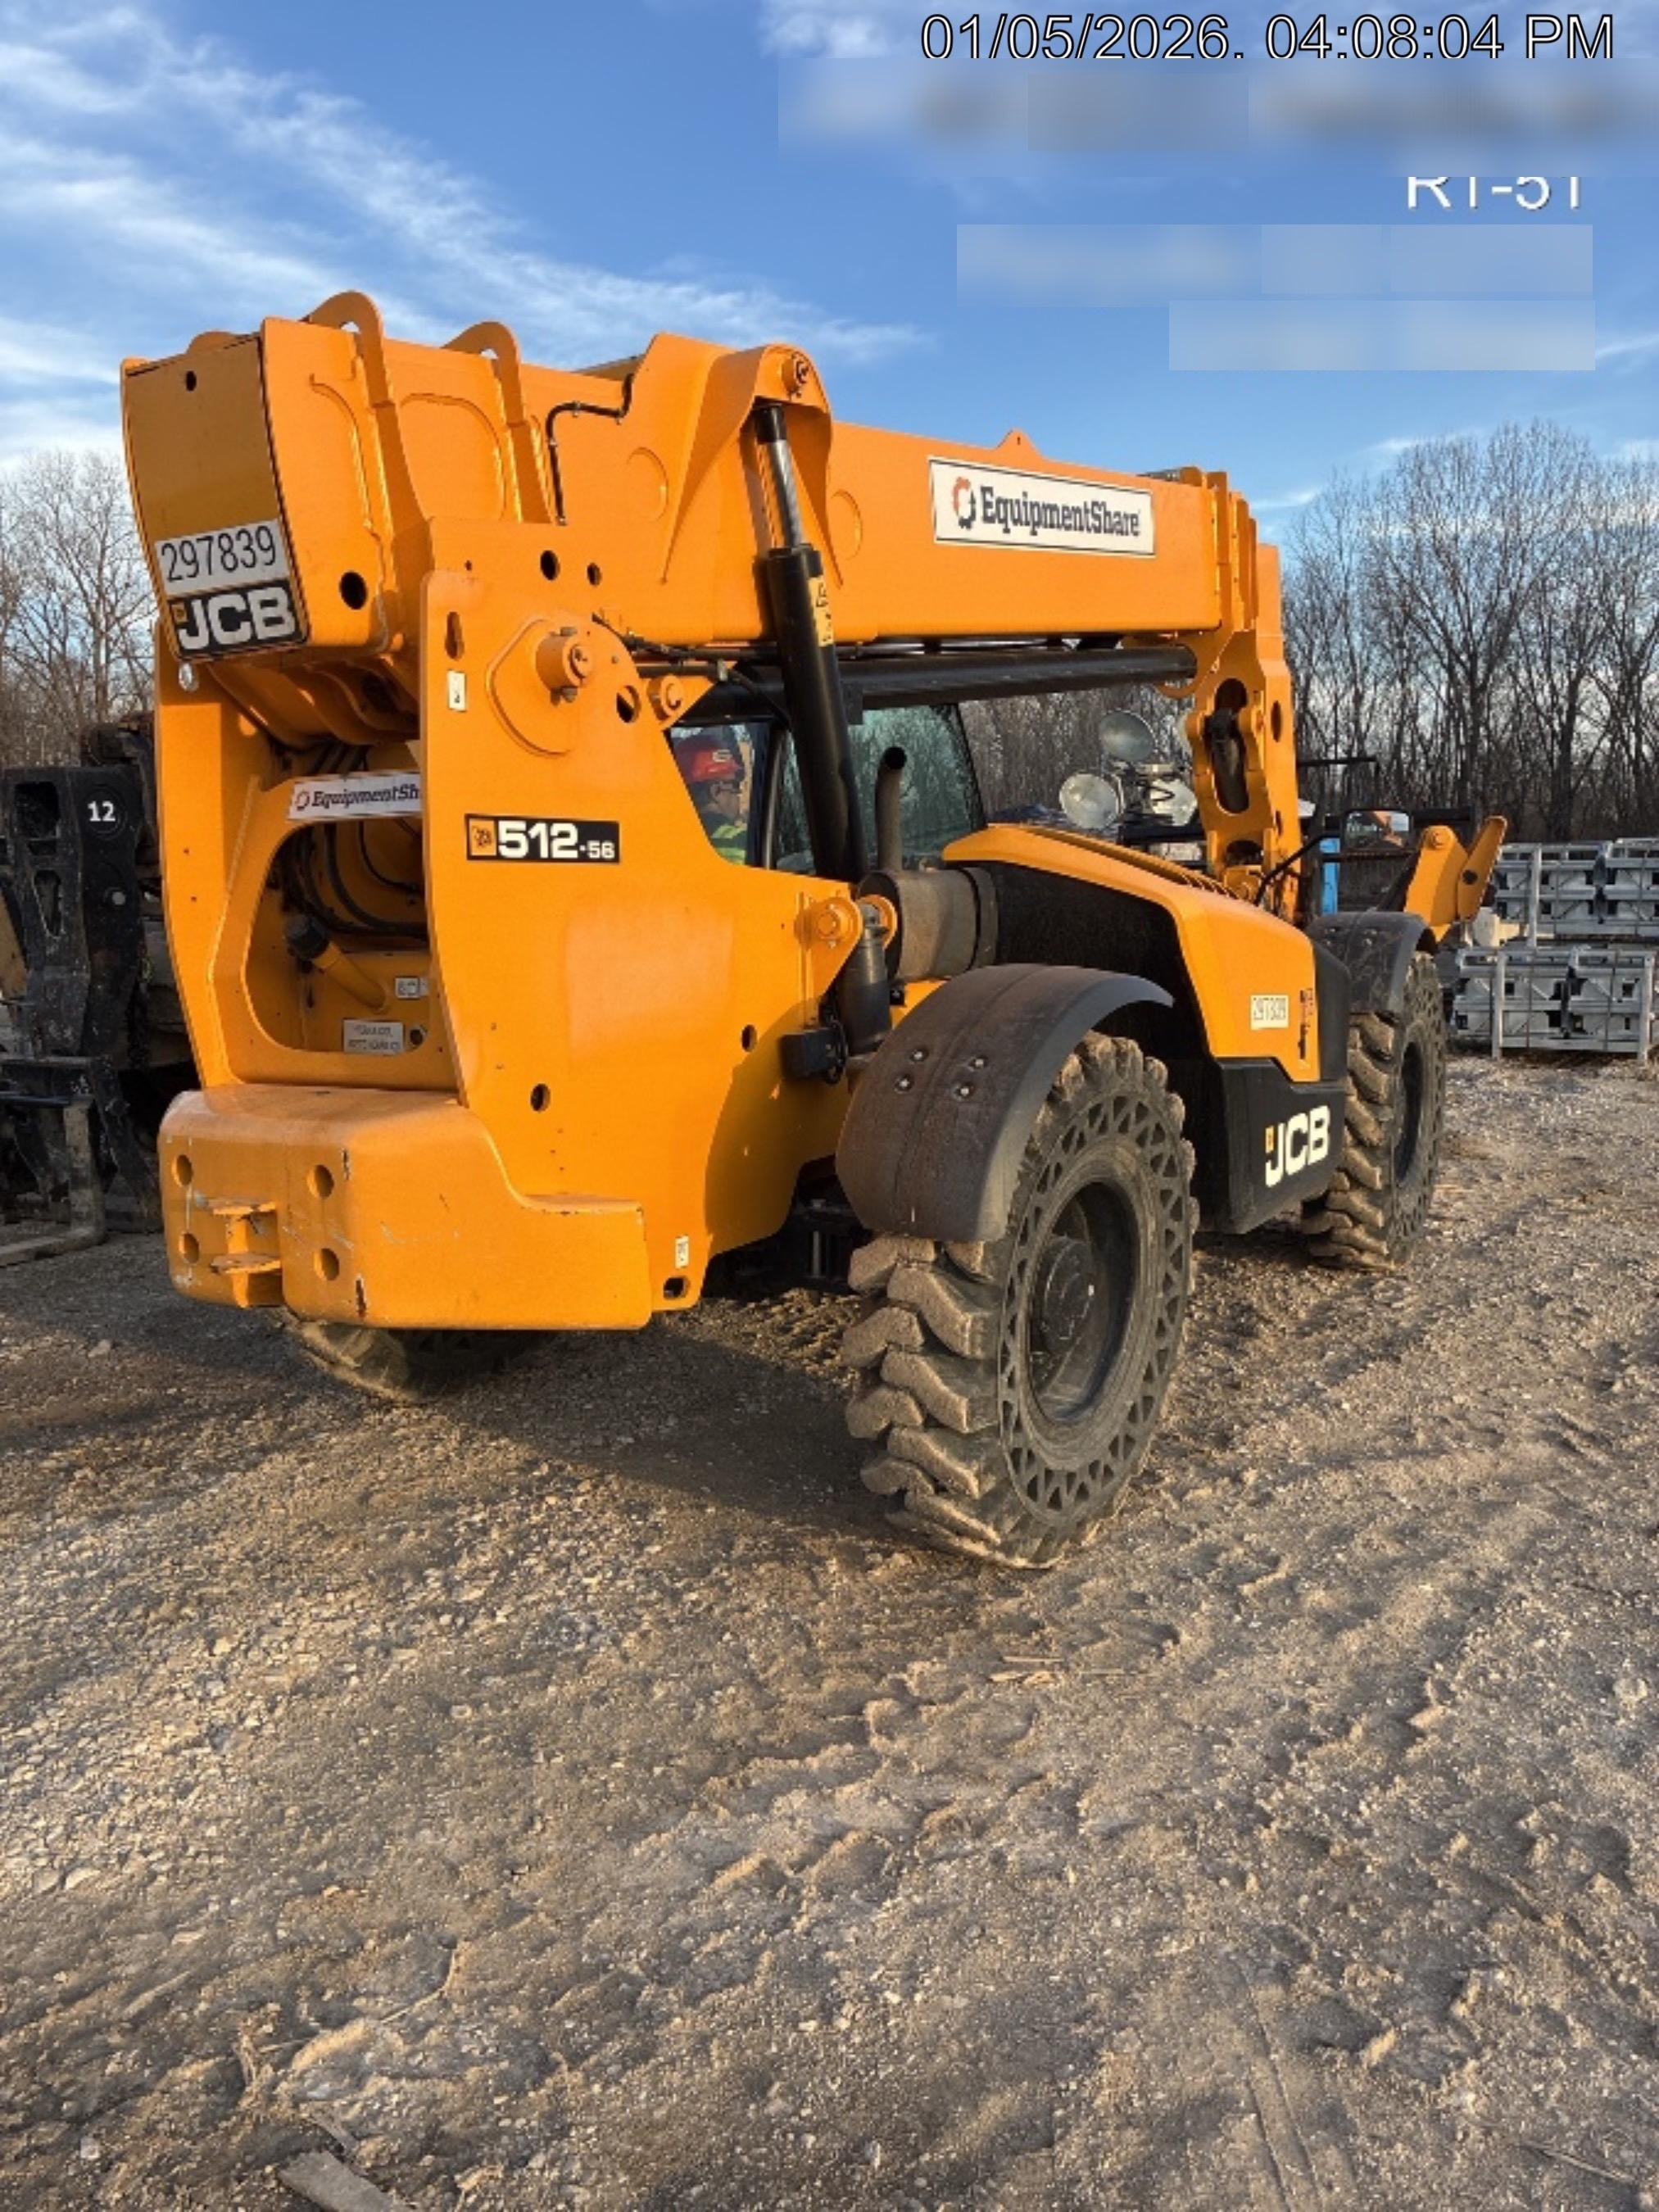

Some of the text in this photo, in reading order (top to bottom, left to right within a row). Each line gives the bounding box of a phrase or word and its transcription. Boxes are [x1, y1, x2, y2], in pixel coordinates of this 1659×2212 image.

[980, 486, 1140, 537] EquipmentShare
[161, 525, 275, 581] 297839
[178, 586, 296, 650] JCB
[88, 800, 116, 822] 12
[1265, 1105, 1330, 1187] JCB
